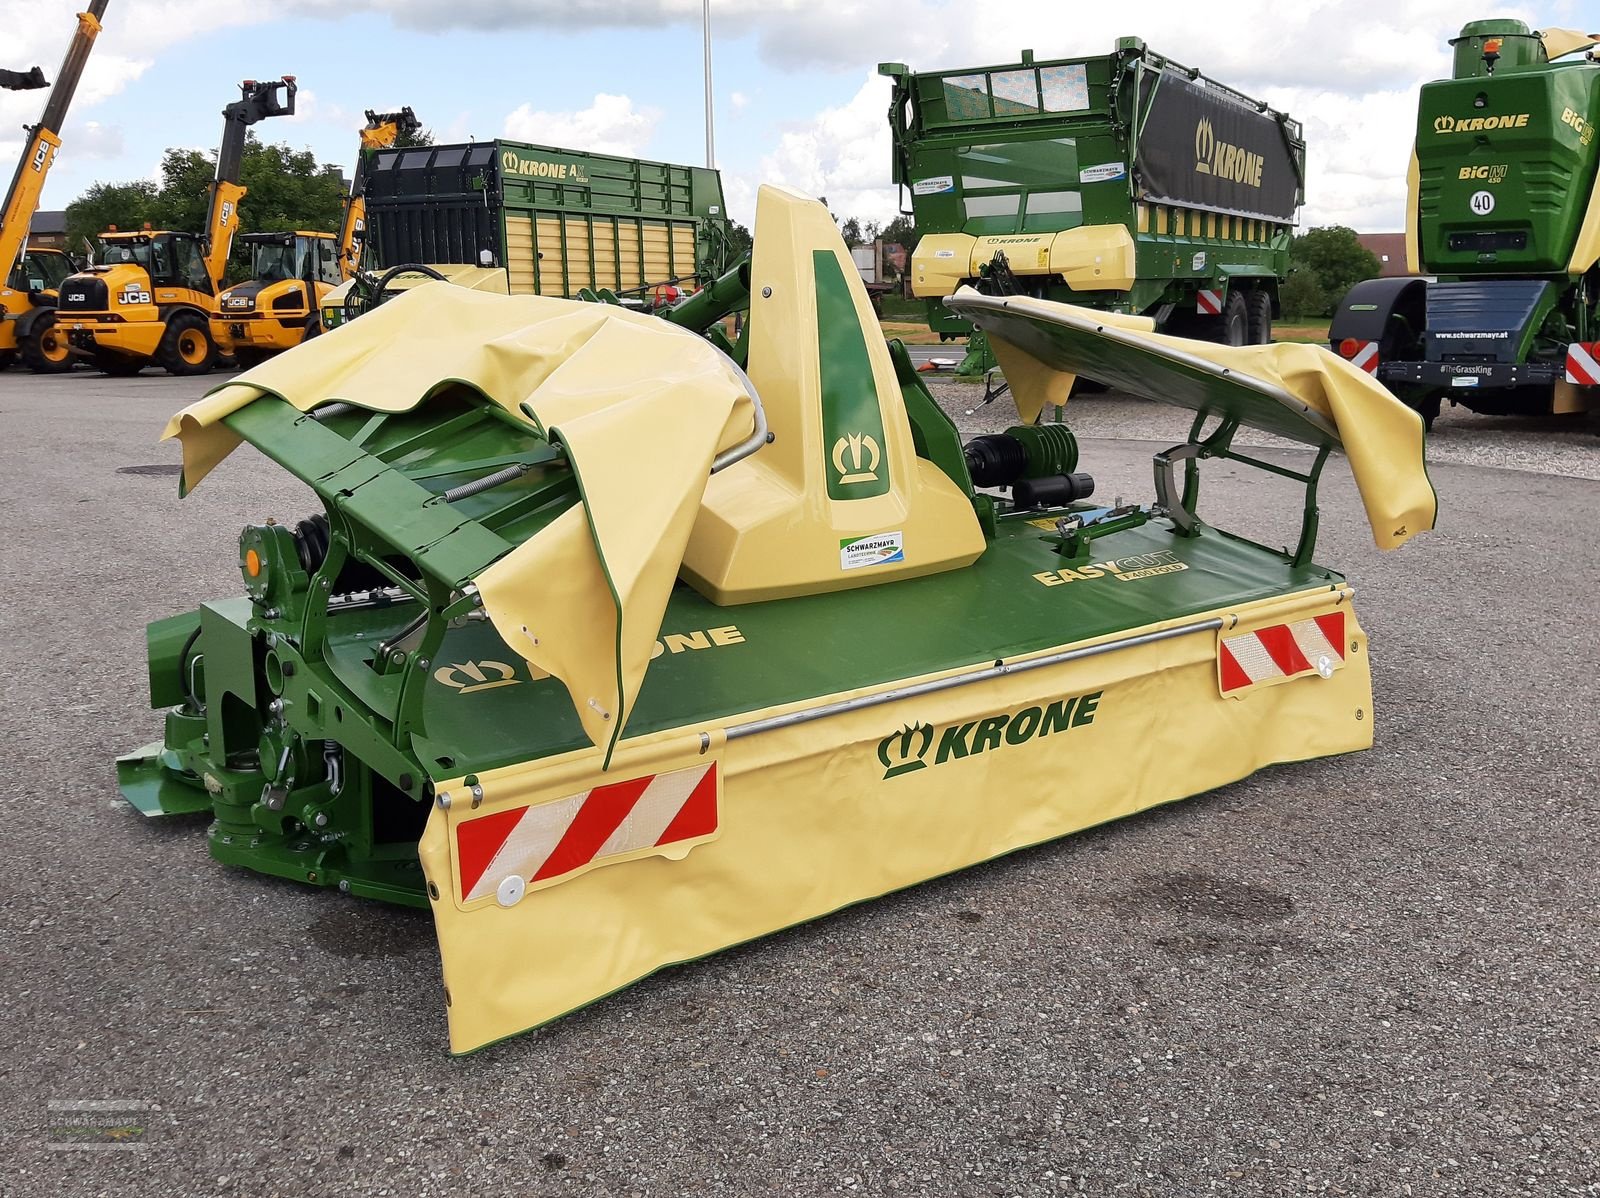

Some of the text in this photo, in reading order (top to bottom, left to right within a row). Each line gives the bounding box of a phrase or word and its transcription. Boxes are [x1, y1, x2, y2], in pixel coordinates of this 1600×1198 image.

[1455, 114, 1530, 132] KRONE
[33, 140, 50, 171] JCB
[519, 160, 567, 179] KRONE
[1213, 141, 1264, 187] KRONE
[1474, 195, 1490, 210] 40
[221, 202, 230, 227] JCB
[68, 293, 86, 302] JCB
[118, 292, 151, 304] JCB
[1435, 331, 1509, 340] www.schwarzmayr.at
[1440, 365, 1493, 377] #TheGrassKing
[846, 539, 896, 553] SCHWARZMAYR
[1132, 569, 1153, 578] 400
[1153, 563, 1184, 574] FOLD
[934, 690, 1105, 765] KRONE
